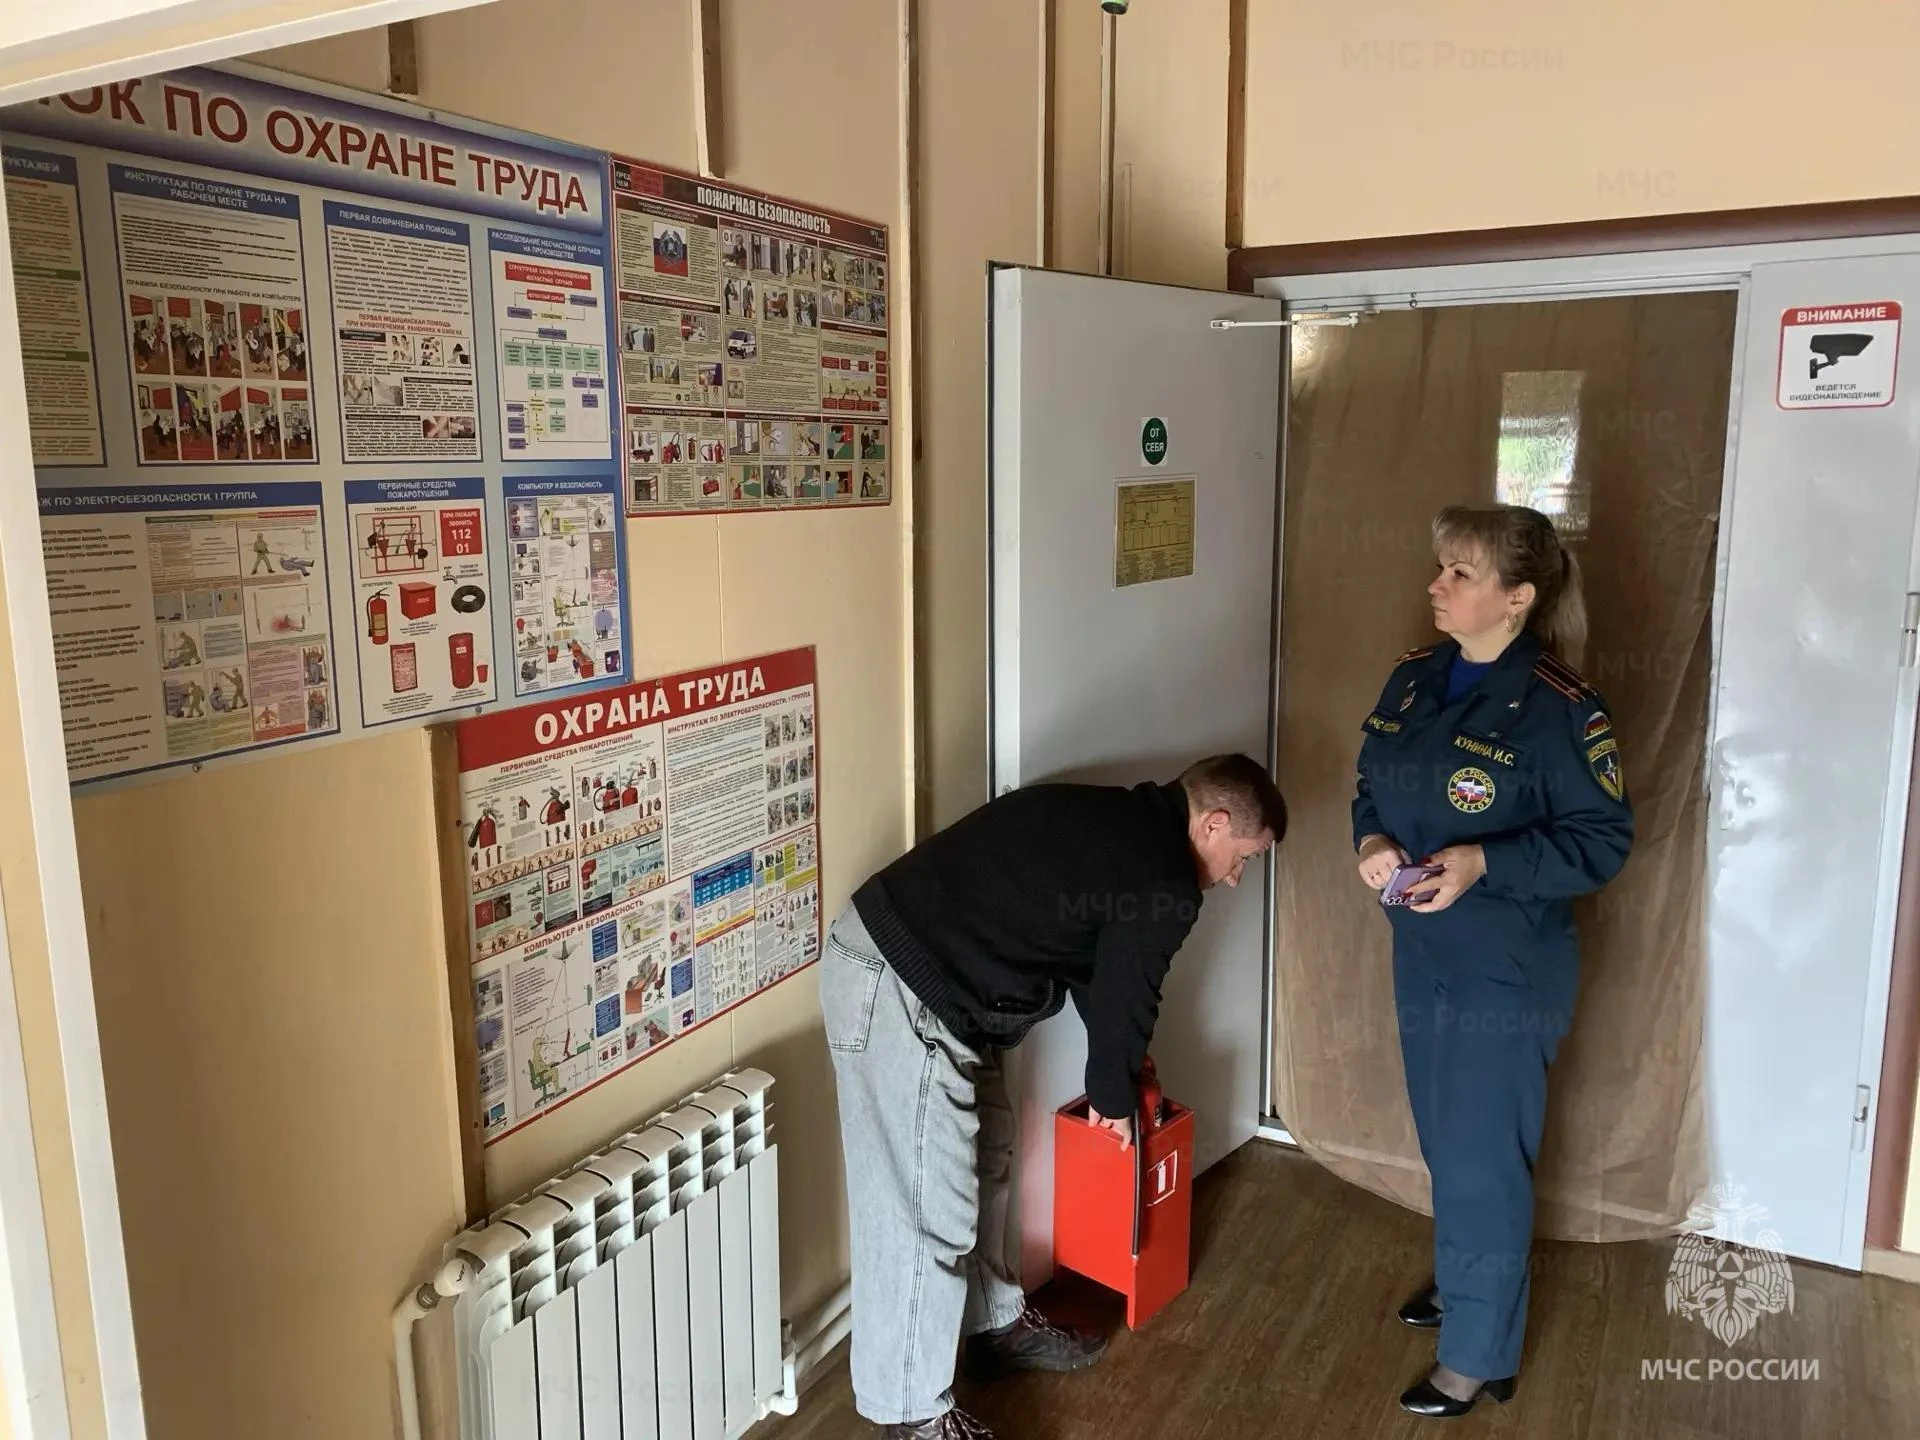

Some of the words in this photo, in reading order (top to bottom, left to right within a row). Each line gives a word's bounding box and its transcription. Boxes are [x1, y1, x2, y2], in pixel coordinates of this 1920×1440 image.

[39, 78, 145, 125] ОК
[164, 84, 248, 143] ПО
[266, 110, 456, 187] ОХРАНЕ
[468, 153, 588, 214] ТРУДА
[125, 170, 189, 190] ИНСТРУКТАЖ
[191, 181, 205, 192] ПО
[207, 184, 243, 198] ОХРАНЕ
[245, 190, 273, 203] ТРУДА
[274, 195, 287, 205] НА
[170, 188, 216, 203] РАБОЧЕМ
[218, 195, 249, 208] МЕСТЕ
[697, 186, 755, 216] ПОЖАРНАЯ
[757, 202, 830, 234] БЕЗОПАСНОСТЬ
[339, 210, 371, 221] ПЕРВАЯ
[371, 215, 424, 231] ДОВРАЧЕБНАЯ
[425, 225, 457, 236] ПОМОЩЬ
[1797, 306, 1887, 323] ВНИМАНИЕ
[1789, 391, 1882, 401] ВИДЕОНАБЛЮДЕНИЕ
[1150, 427, 1160, 438] ОТ
[1145, 442, 1164, 453] СЕБЯ
[377, 481, 421, 490] ПЕРВИЧНЫЕ
[422, 480, 456, 489] СРЕДСТВА
[387, 489, 449, 499] ПОЖАРОТУШЕНИЯ
[517, 482, 554, 490] КОМПЬЮТЕР
[559, 481, 603, 489] БЕЗОПАСНОСТЬ
[37, 497, 52, 507] Ж
[55, 497, 71, 506] ПО
[220, 491, 258, 501] ГРУППА
[452, 528, 472, 540] 112
[456, 543, 470, 554] 01
[534, 688, 670, 745] ОХРАНА
[678, 666, 766, 709] ТРУДА
[667, 715, 709, 734] ИНСТРУКТАЖ
[709, 713, 718, 724] ПО
[500, 757, 543, 774] ПЕРВИЧНЫЕ
[544, 748, 578, 762] СРЕДСТВА
[579, 733, 633, 753] ПОЖАРОТУШЕНИЯ
[1454, 735, 1493, 758] КУНИНА
[1493, 748, 1514, 767] И.С.
[524, 927, 576, 955] КОМПЬЮТЕР
[577, 923, 584, 932] И
[585, 900, 644, 928] БЕЗОПАСНОСТЬ
